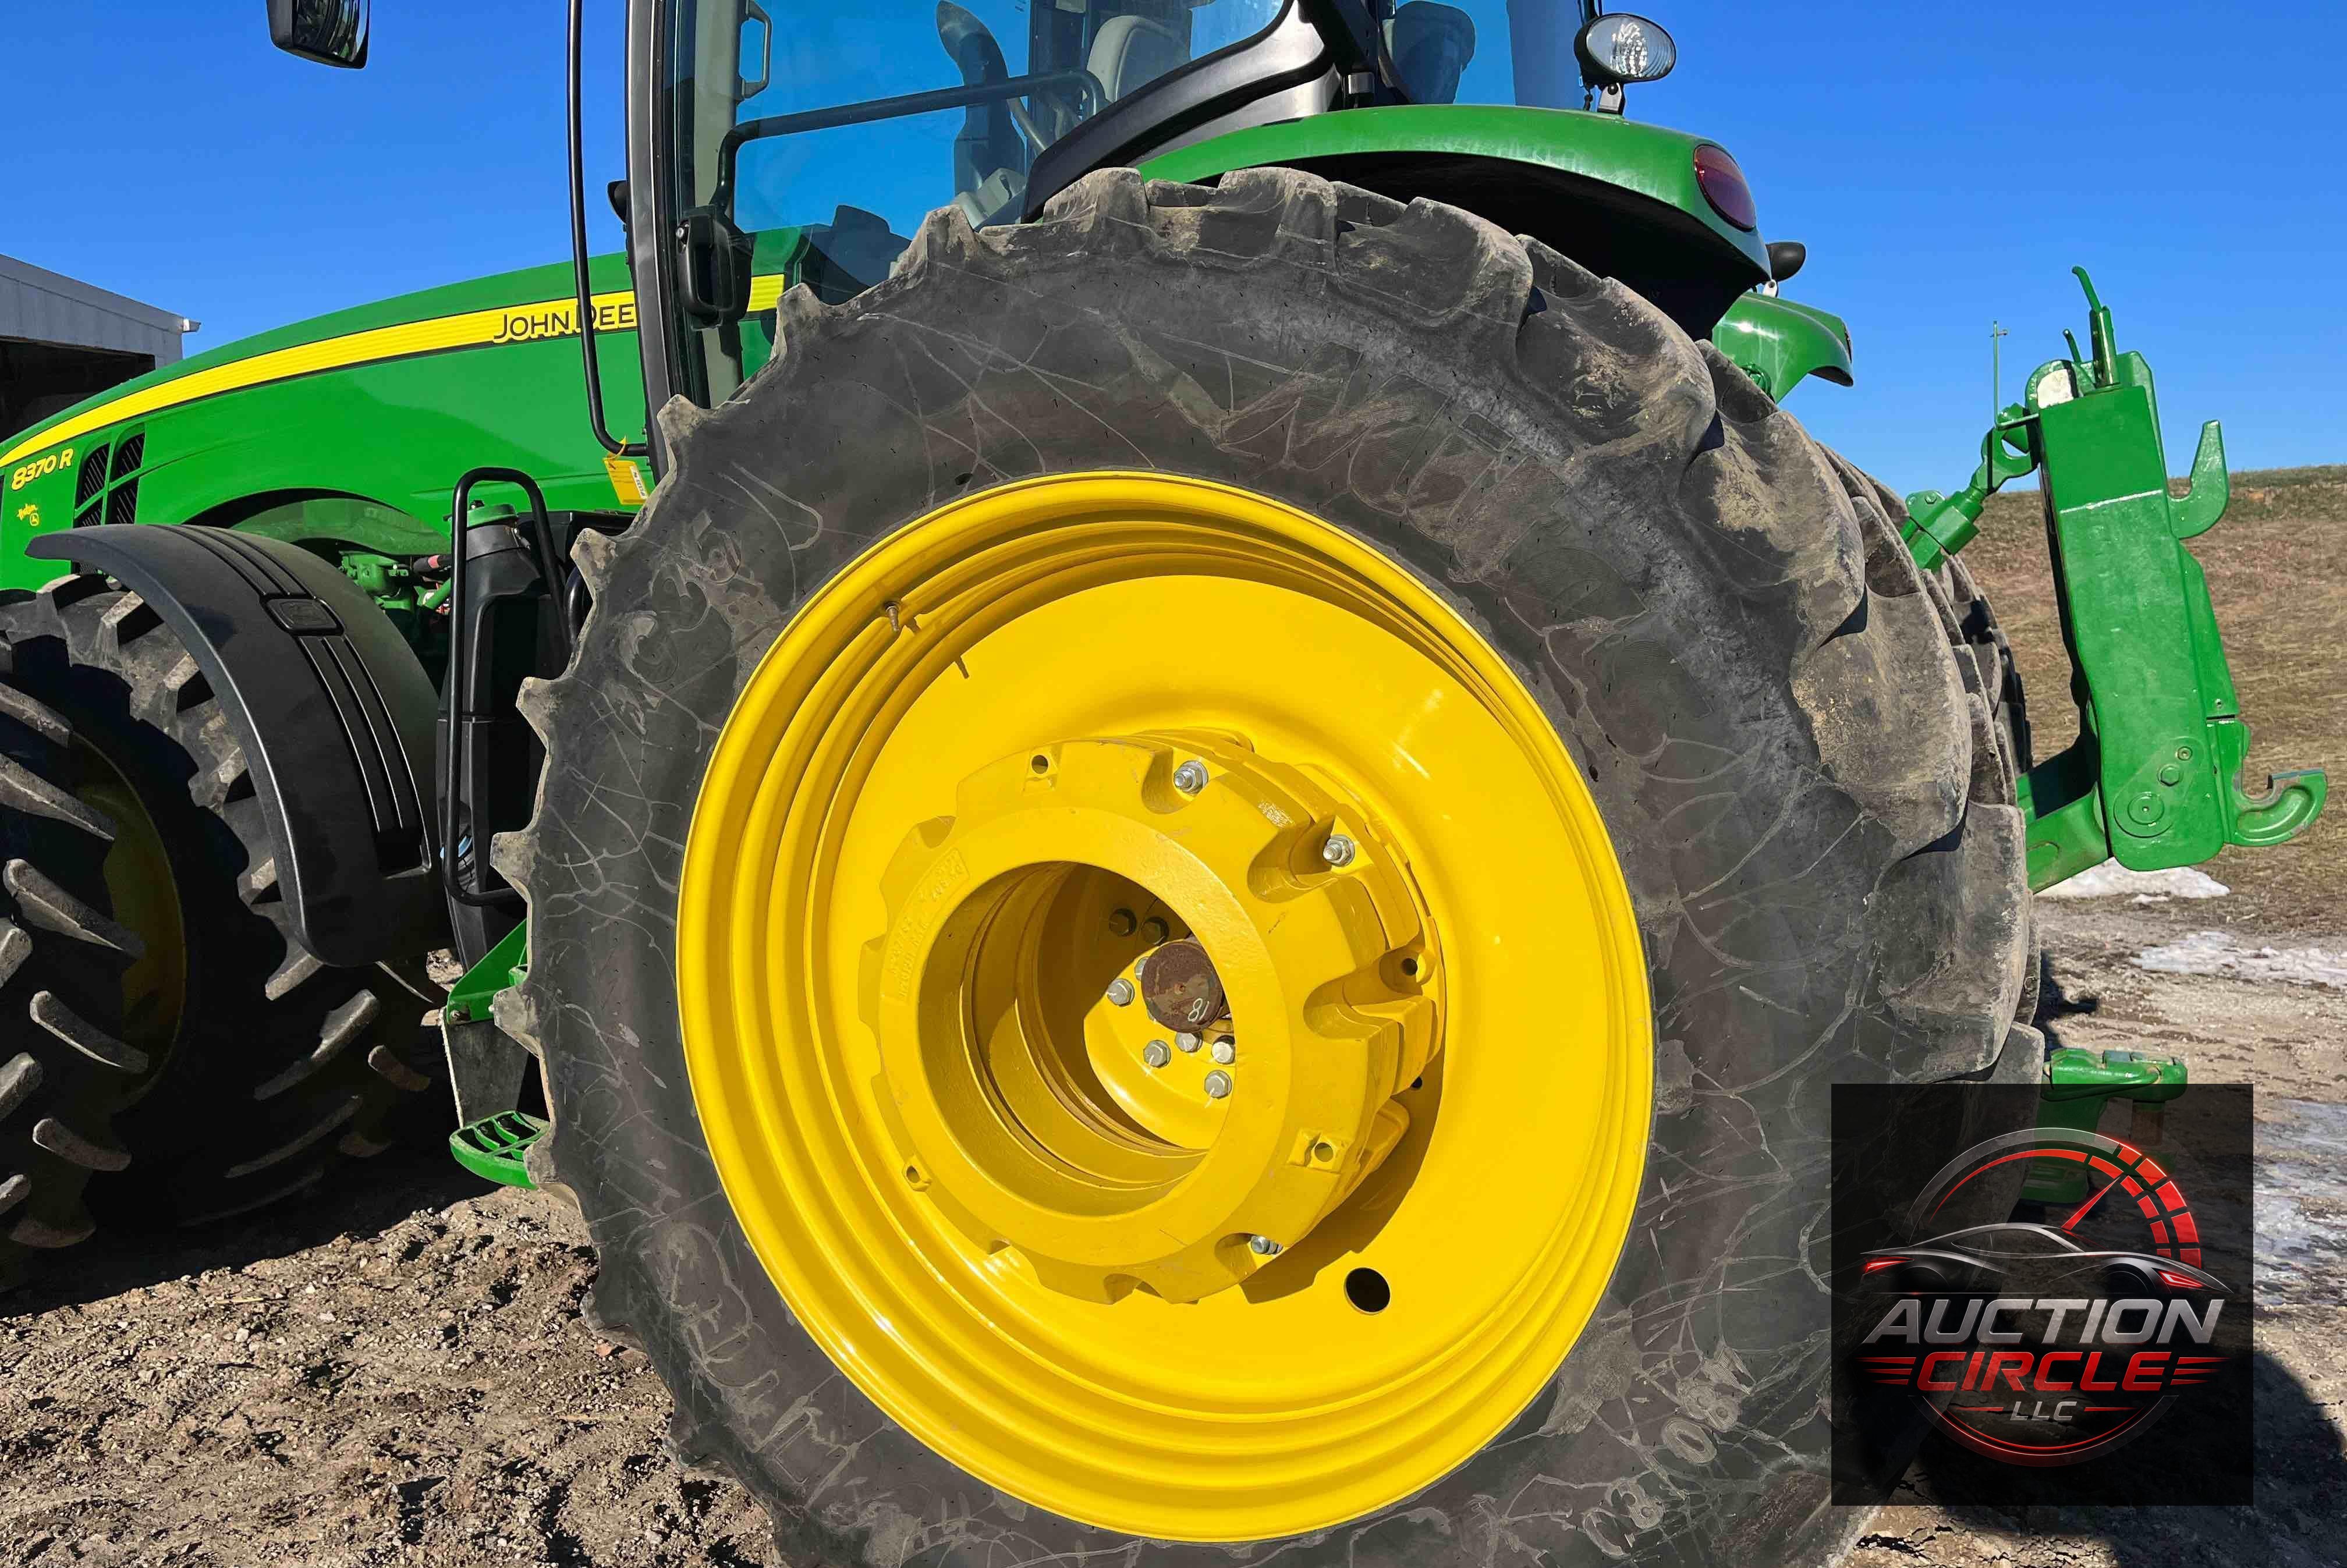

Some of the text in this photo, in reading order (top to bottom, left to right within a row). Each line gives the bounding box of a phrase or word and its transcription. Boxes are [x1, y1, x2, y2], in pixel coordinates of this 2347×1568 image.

[493, 303, 636, 341] JOHN DEE
[12, 455, 57, 490] 8370
[1187, 998, 1210, 1022] 81
